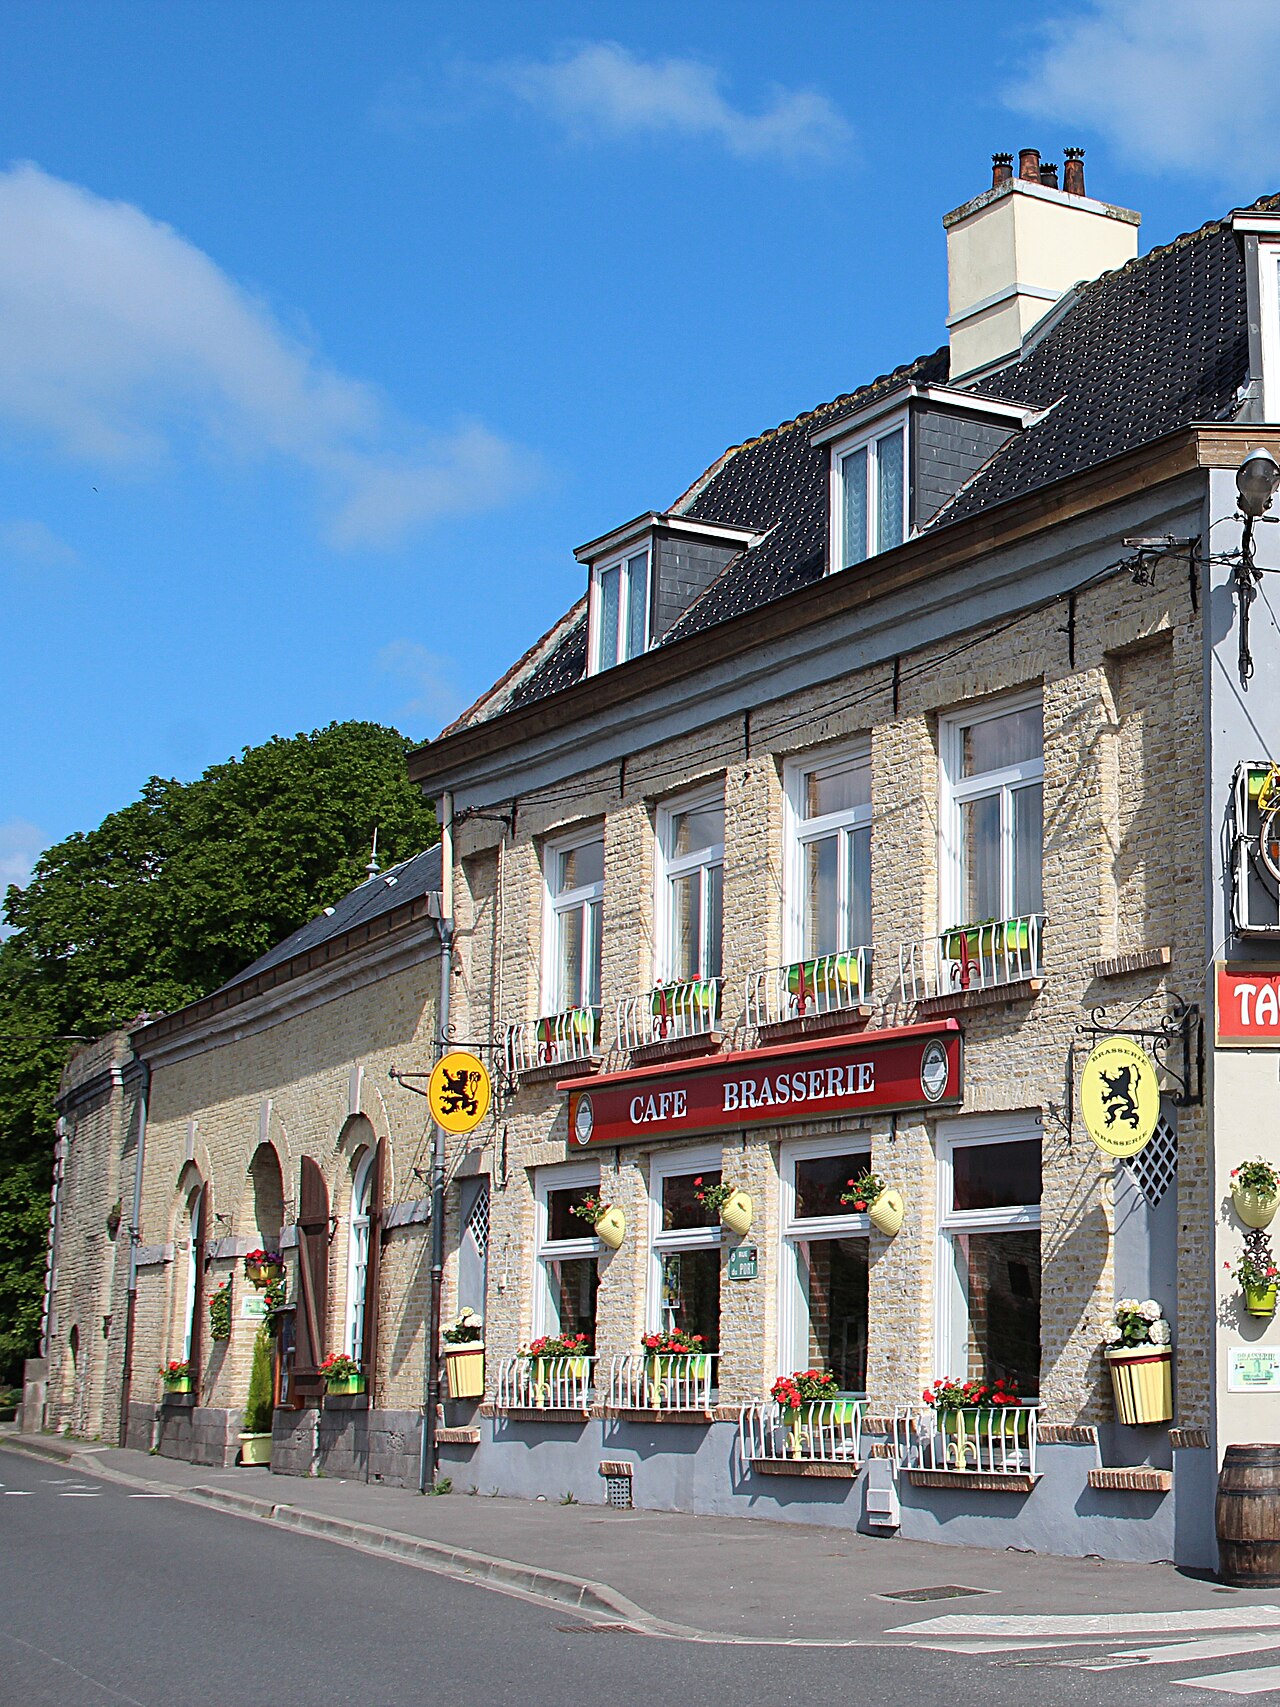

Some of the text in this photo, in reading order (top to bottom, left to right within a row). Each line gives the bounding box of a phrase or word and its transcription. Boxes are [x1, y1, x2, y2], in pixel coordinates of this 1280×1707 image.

[1091, 1047, 1148, 1067] BRASSERIE
[629, 1089, 688, 1125] CAFE
[722, 1062, 875, 1112] BRASSERIE
[1094, 1129, 1148, 1147] BRASSERIE
[739, 1262, 754, 1275] PORT
